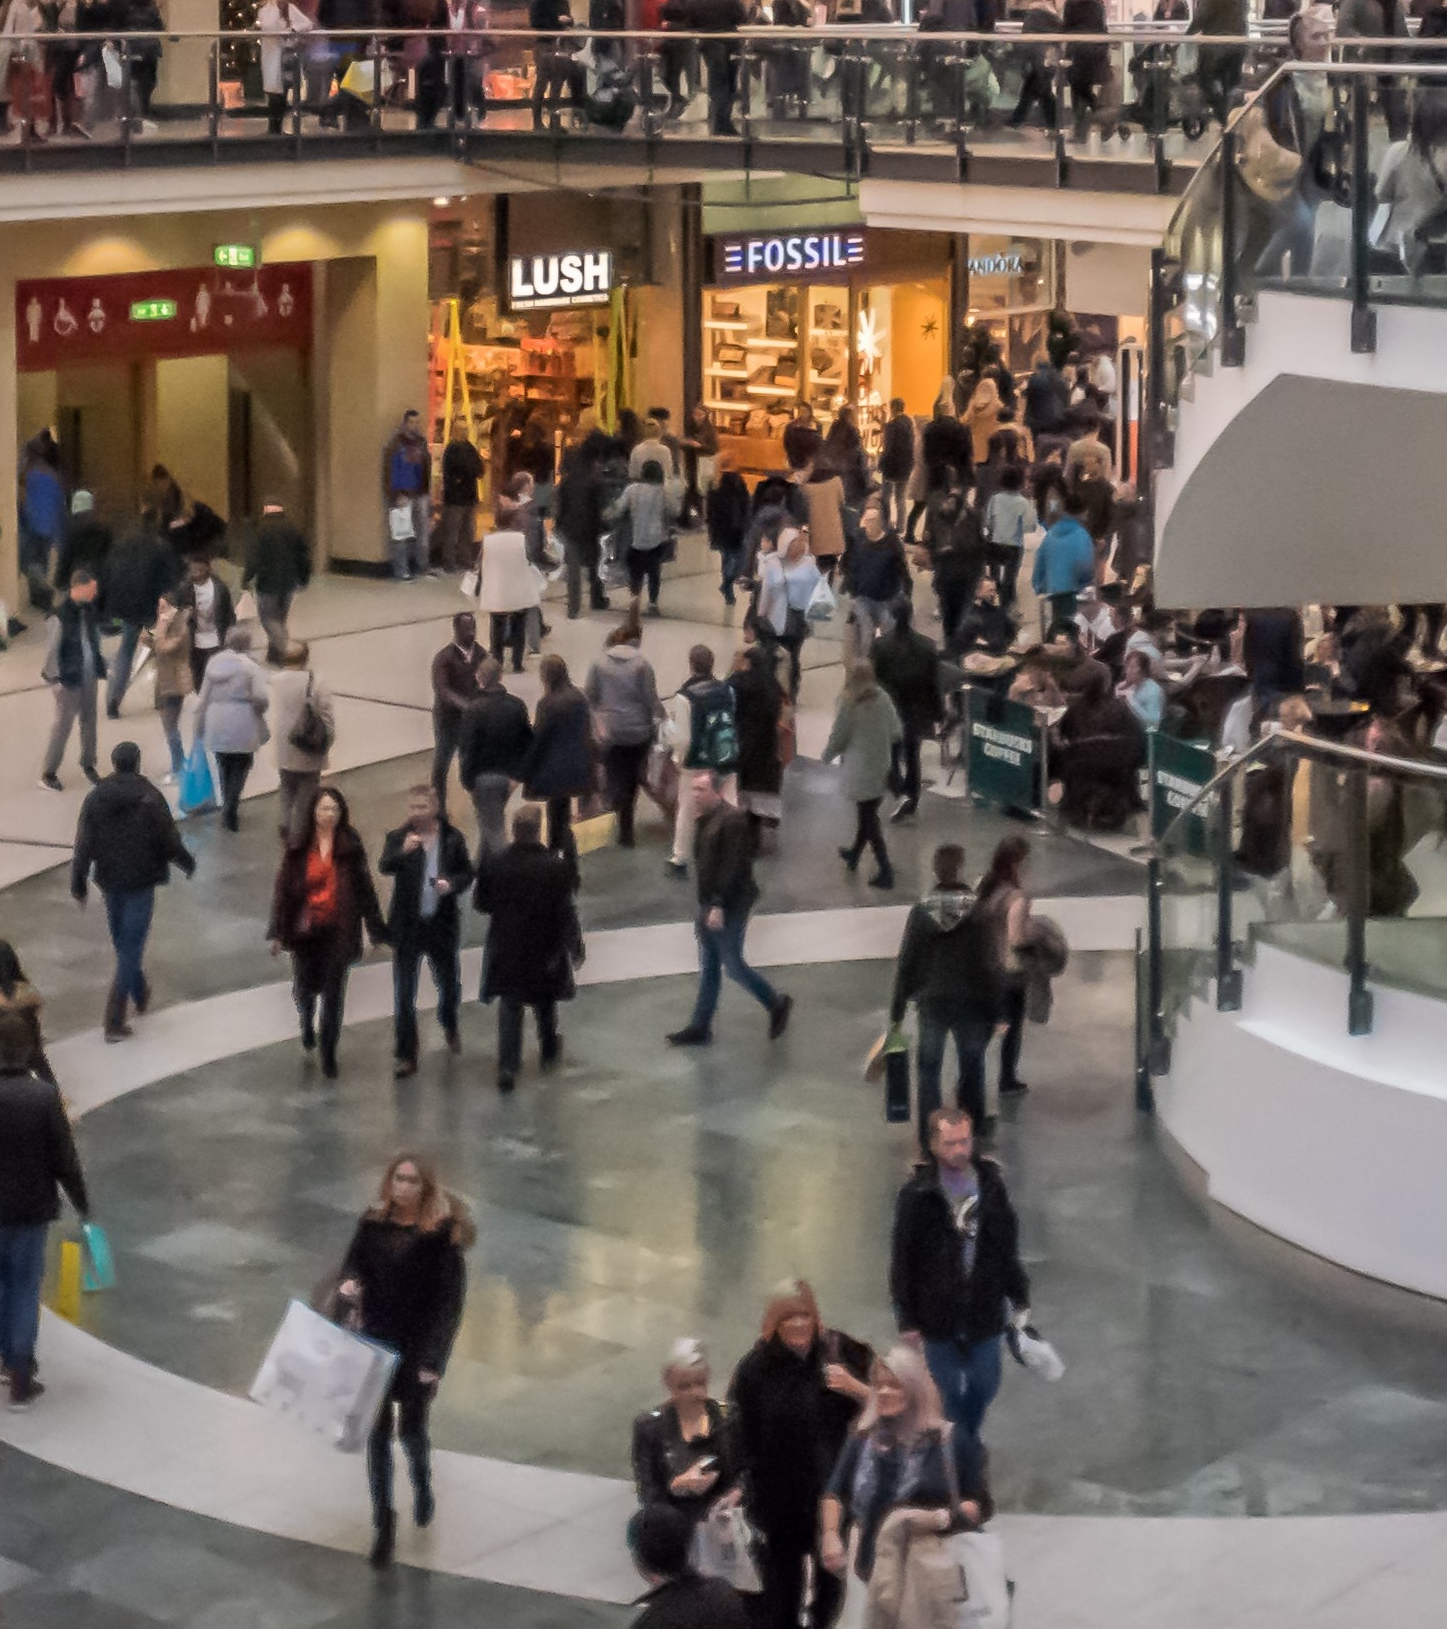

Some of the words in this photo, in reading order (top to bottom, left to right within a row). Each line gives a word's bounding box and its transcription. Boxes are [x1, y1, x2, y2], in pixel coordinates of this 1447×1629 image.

[747, 236, 847, 273] FOSSIL
[966, 255, 1024, 274] ANDORA
[511, 252, 609, 297] LUSH
